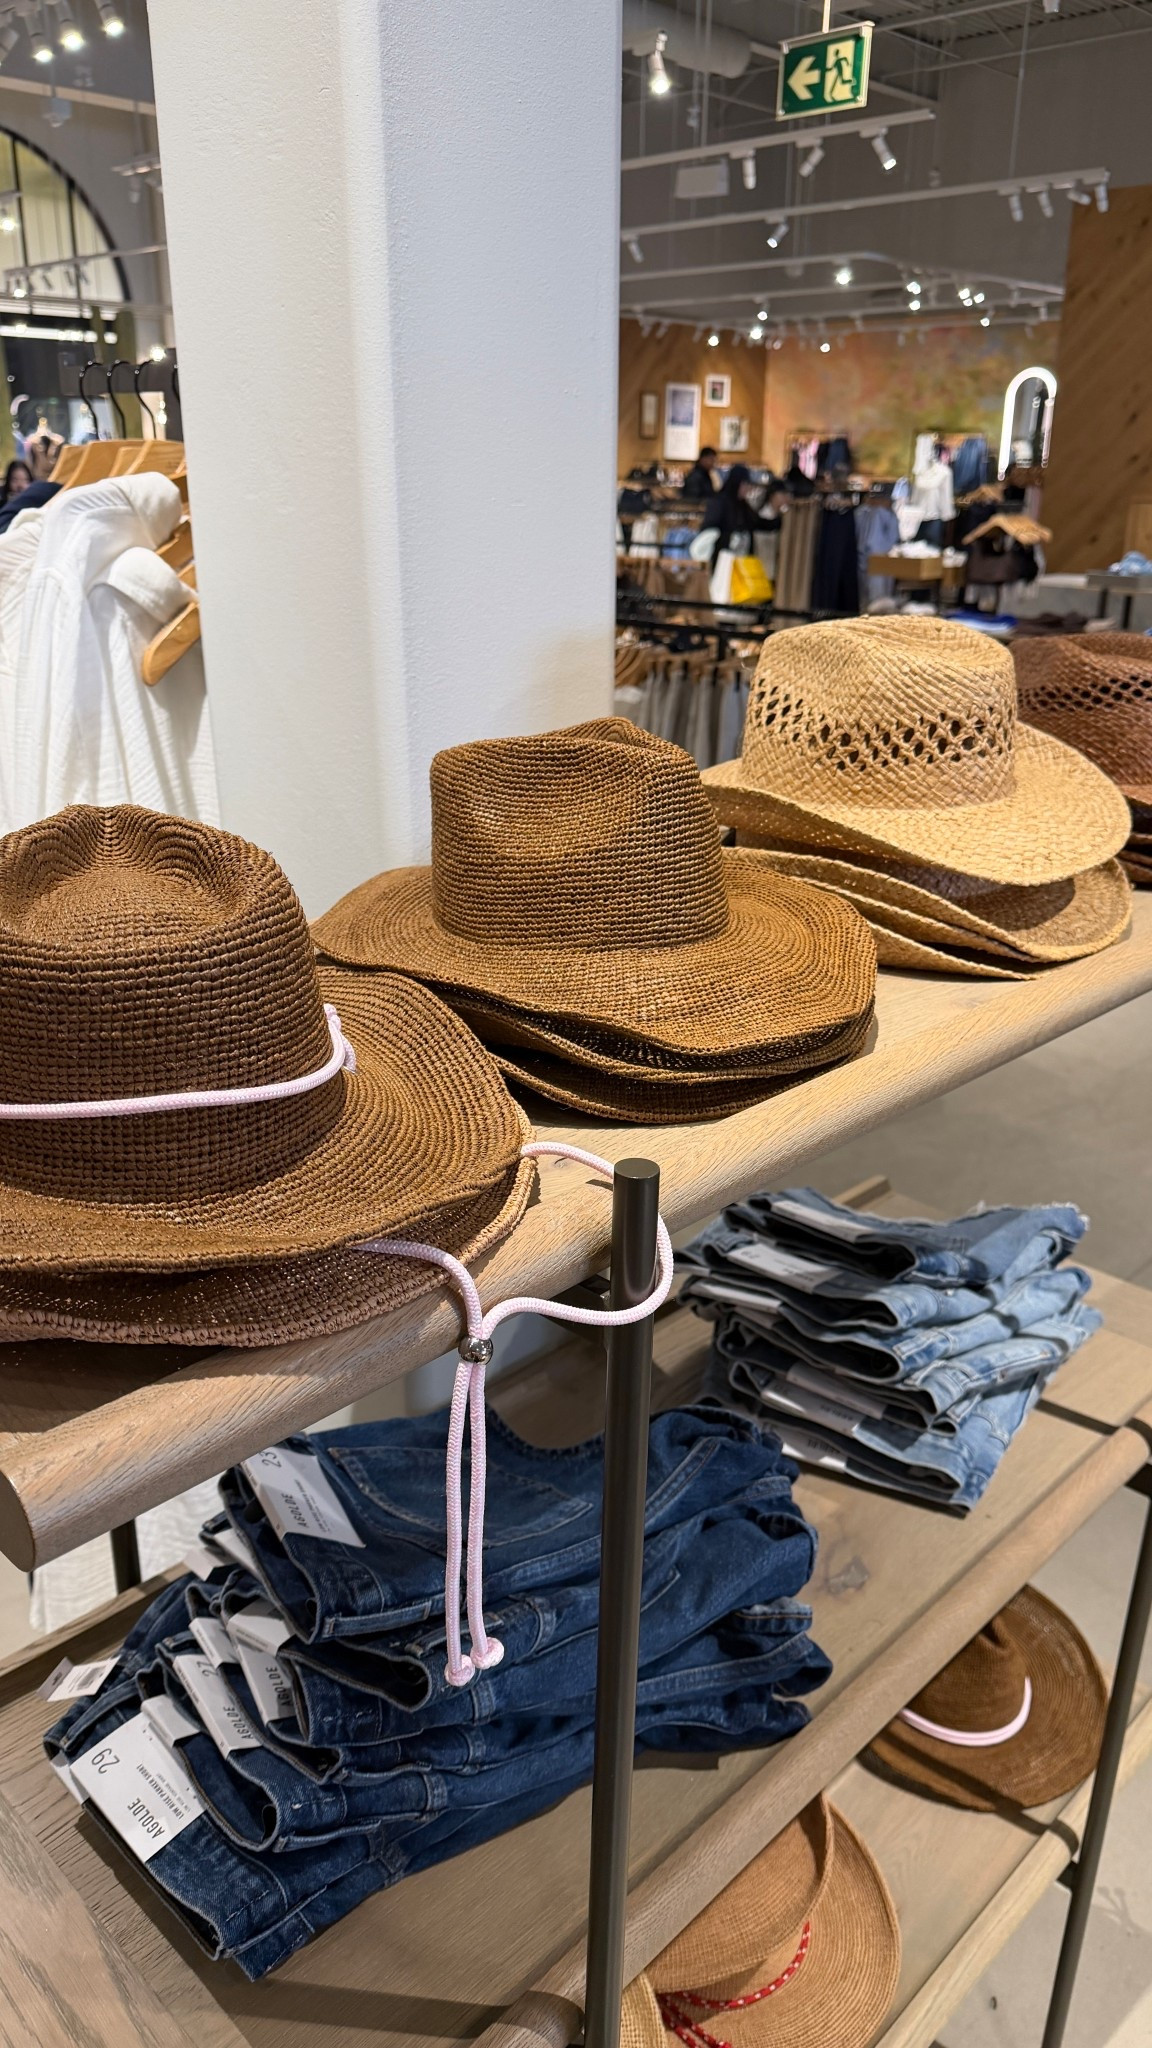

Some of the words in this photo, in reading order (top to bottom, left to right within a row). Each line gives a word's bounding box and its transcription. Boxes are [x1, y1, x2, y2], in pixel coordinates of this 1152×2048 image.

[260, 1451, 282, 1468] 23
[281, 1492, 309, 1529] AGOLDE
[266, 1666, 293, 1706] AGOLDE
[223, 1706, 253, 1740] AGOLDE
[91, 1748, 120, 1774] 29
[127, 1797, 165, 1839] AGOLDE
